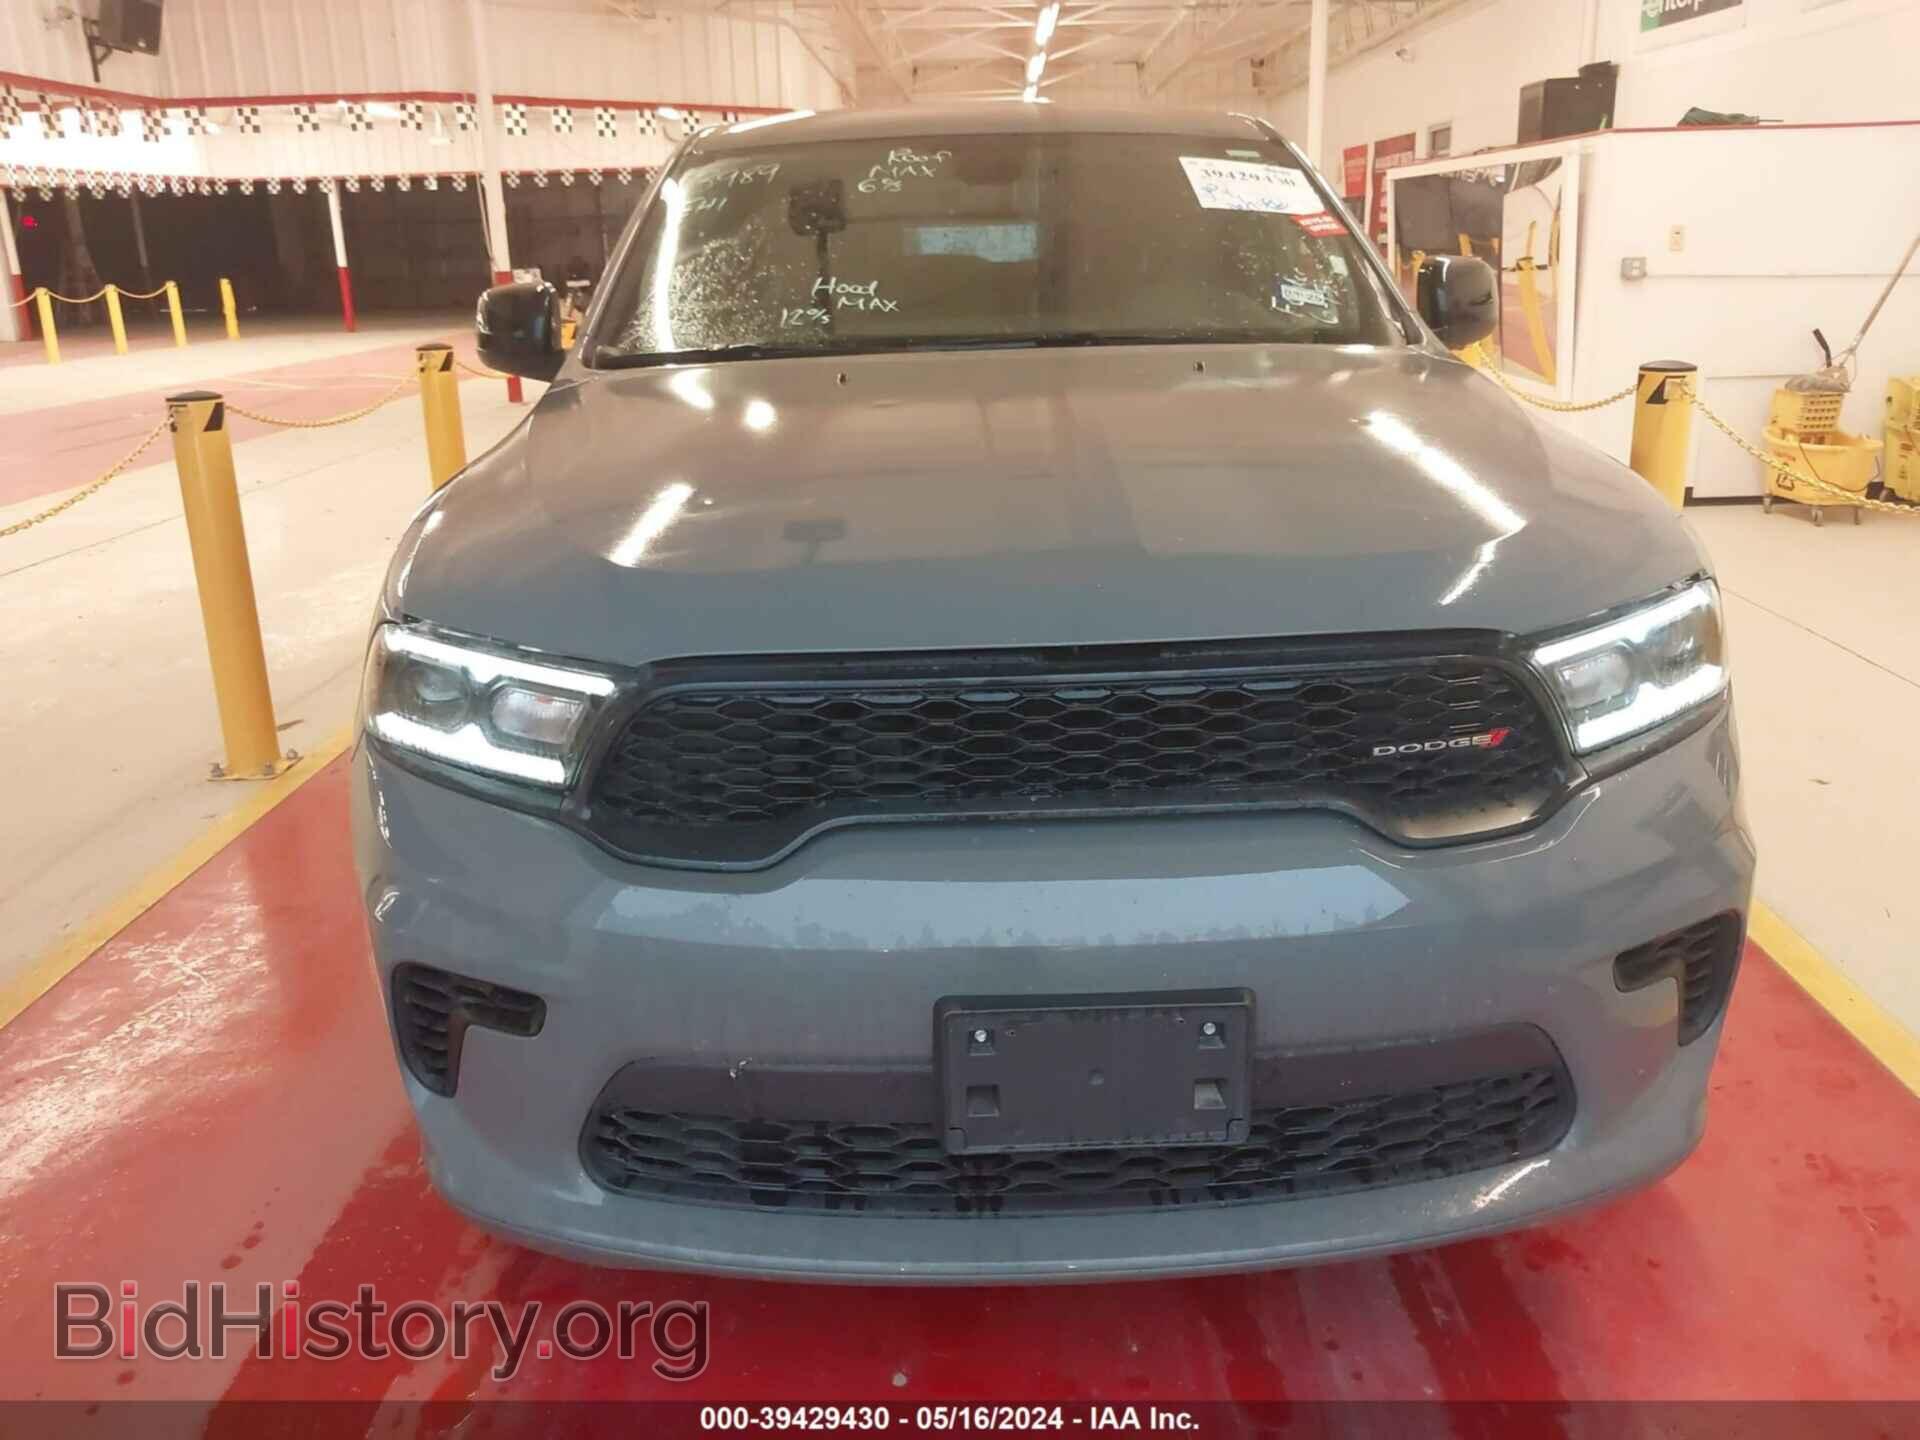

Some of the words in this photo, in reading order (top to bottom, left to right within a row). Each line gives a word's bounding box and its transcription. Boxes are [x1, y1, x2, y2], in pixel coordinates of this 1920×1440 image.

[869, 164, 937, 178] MAX
[811, 276, 879, 297] Hood
[837, 296, 900, 312] MAX
[1373, 734, 1493, 757] DODGE
